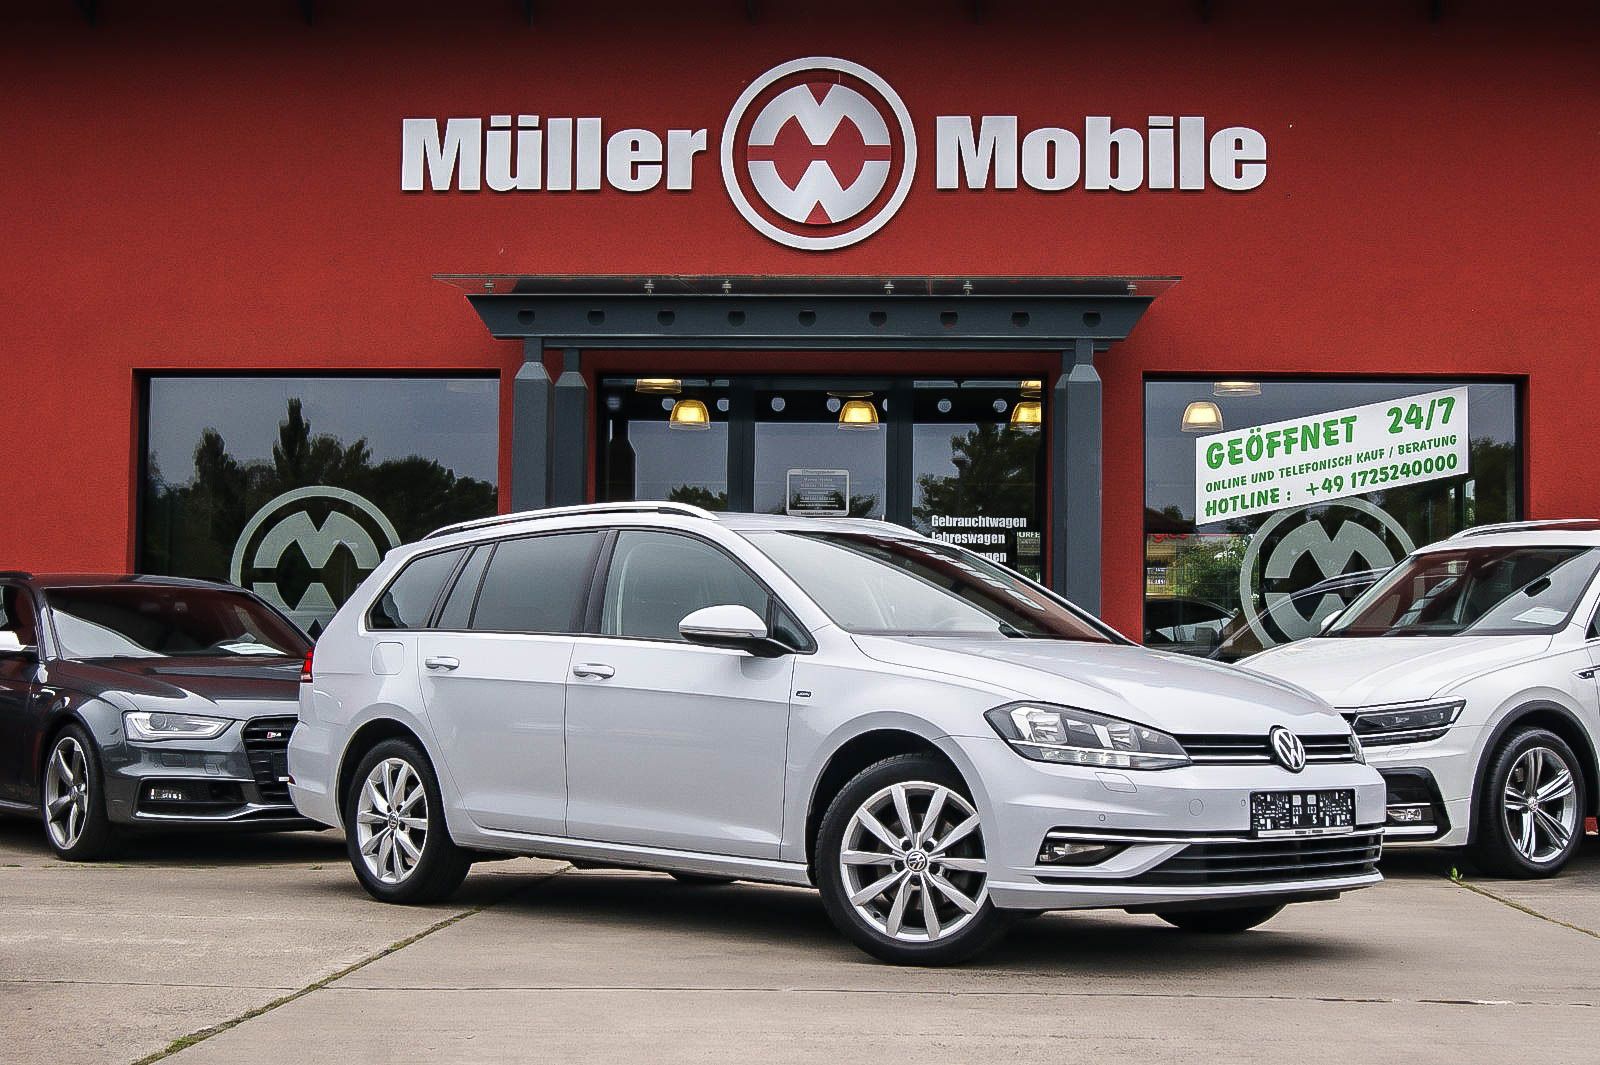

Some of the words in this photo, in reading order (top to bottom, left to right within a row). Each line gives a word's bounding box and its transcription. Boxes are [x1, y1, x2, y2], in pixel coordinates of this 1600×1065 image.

[402, 115, 707, 191] Müller
[937, 116, 1266, 191] Mobile
[1206, 415, 1357, 469] GEÖFFNET
[1387, 396, 1456, 434] 24/7
[1205, 475, 1247, 493] ONLINE
[1251, 470, 1275, 484] UND
[1279, 455, 1352, 478] TELEFONISCH
[1356, 448, 1385, 464] KAUF
[1397, 434, 1457, 456] BERATUNG
[1205, 488, 1280, 517] HOTLINE
[1305, 475, 1344, 496] +49
[1350, 453, 1458, 489] 1725240000
[931, 514, 1027, 529] Gebrauchtwagen
[931, 532, 1006, 546] Jahreswagen
